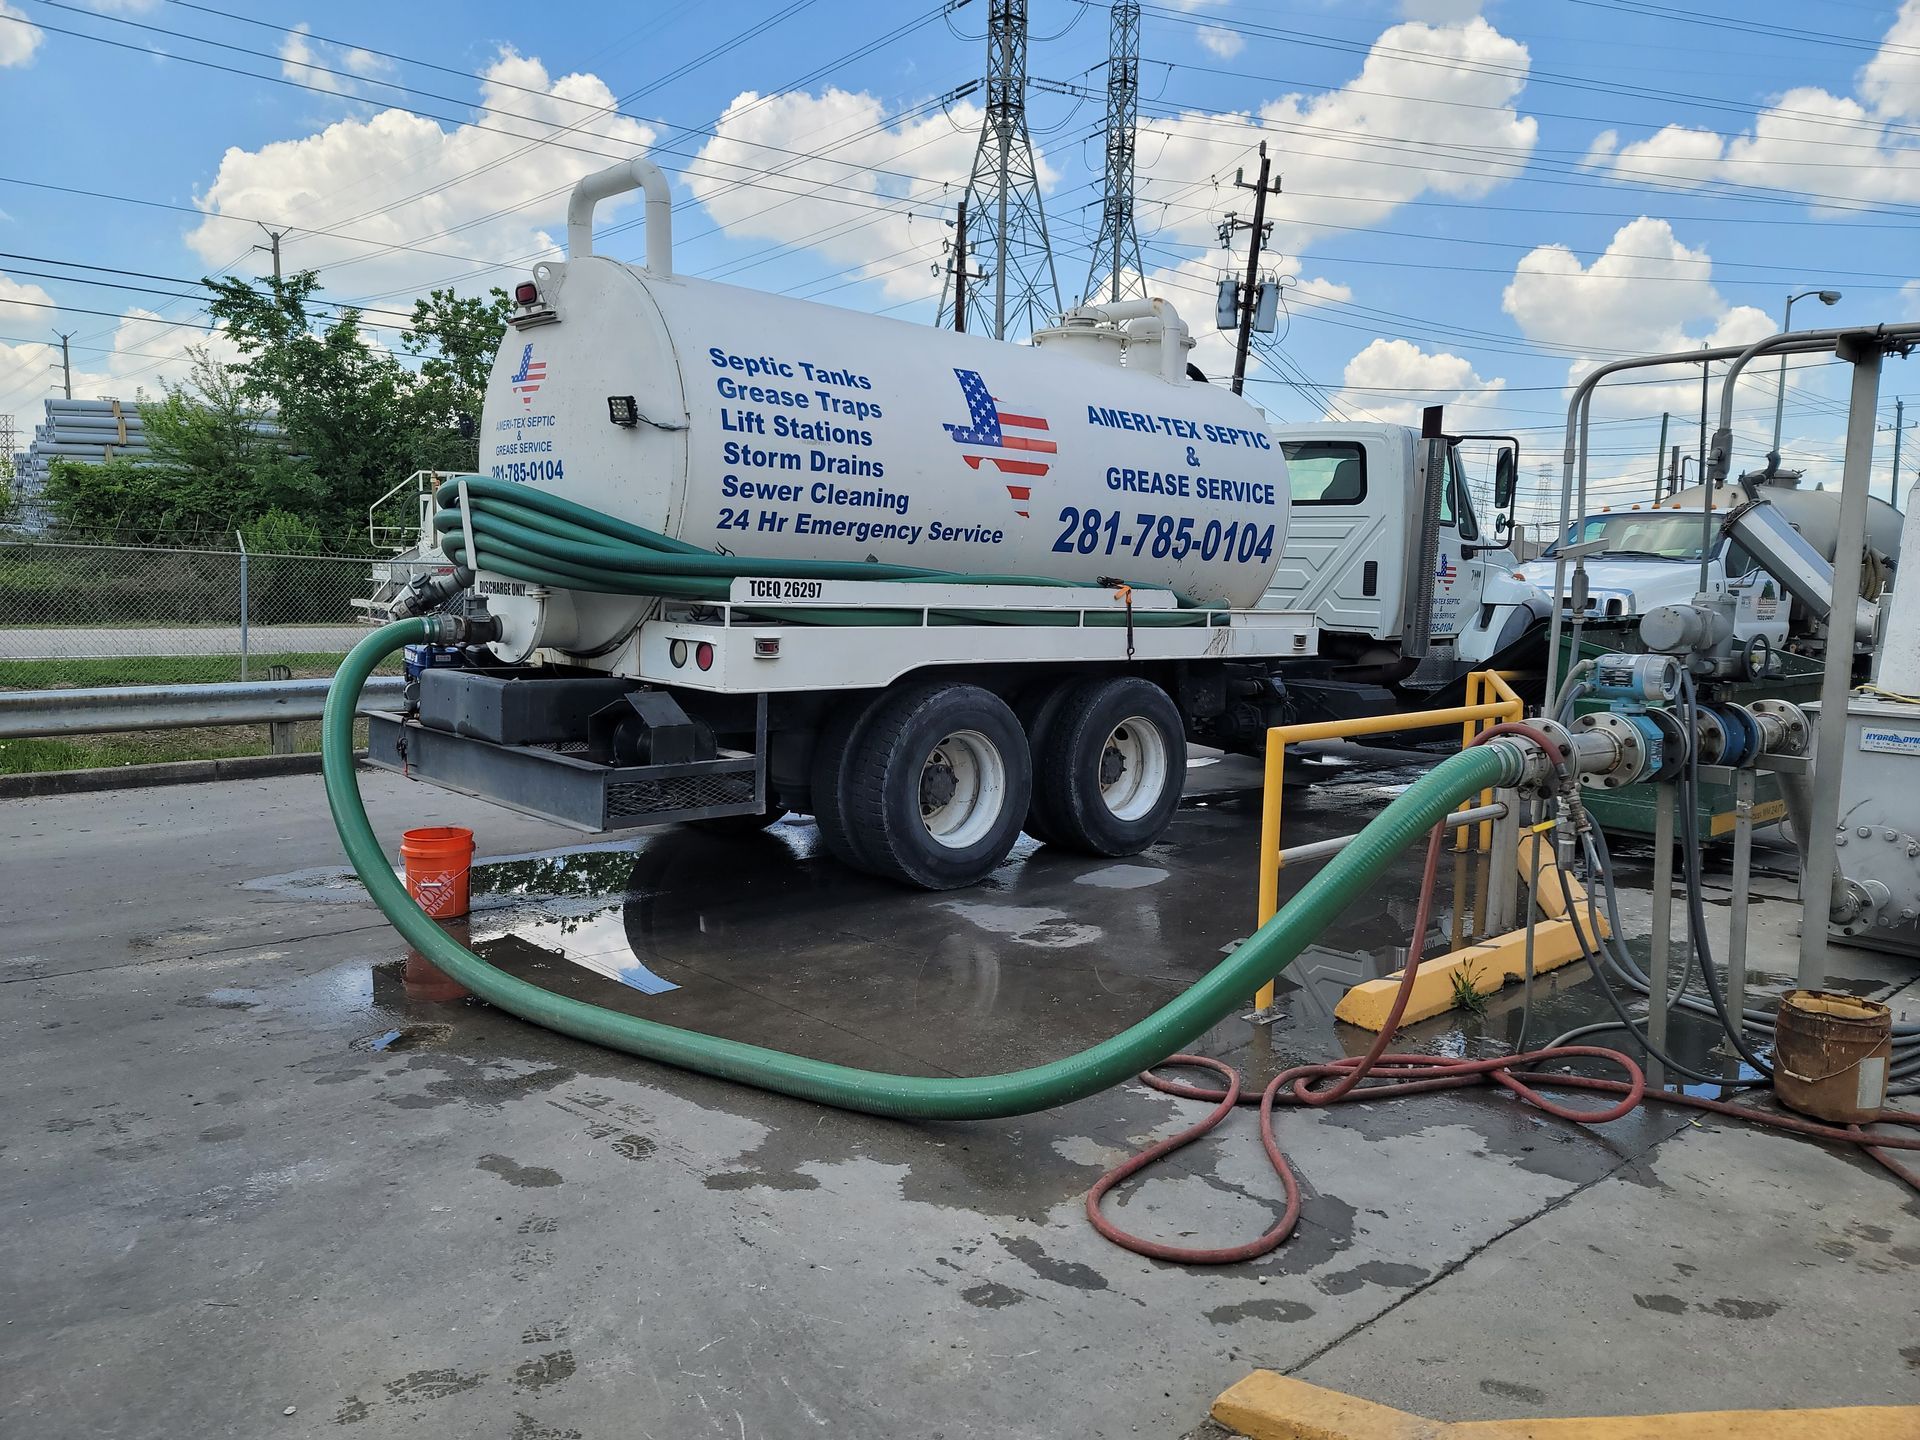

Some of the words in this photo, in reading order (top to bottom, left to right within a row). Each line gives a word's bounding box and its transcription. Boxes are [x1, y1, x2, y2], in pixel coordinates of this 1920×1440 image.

[709, 347, 794, 379] Septic
[798, 361, 872, 390] Tanks
[717, 377, 809, 409] Grease
[815, 390, 883, 421] Traps
[496, 417, 526, 432] AMERI-TEX
[527, 415, 556, 428] SEPTIC
[517, 430, 522, 441] &
[721, 408, 765, 435] Lift
[773, 414, 873, 447] Stations
[1087, 405, 1202, 440] AMERI-TEX
[1204, 423, 1271, 450] SEPTIC
[496, 443, 518, 456] GREASE
[519, 441, 552, 454] SERVICE
[723, 441, 800, 471] Storm
[810, 450, 884, 478] Drains
[1186, 446, 1201, 467] &
[491, 459, 564, 482] 281-785-0104
[1106, 466, 1190, 497] GREASE
[1196, 476, 1275, 505] SERVICE
[722, 474, 803, 502] Sewer
[810, 482, 910, 515] Cleaning
[716, 508, 750, 531] 24
[757, 510, 789, 534] Hr
[794, 512, 923, 545] Emergency
[928, 521, 1004, 544] Service
[1051, 506, 1275, 564] 281-785-0104
[479, 580, 510, 596] DISCHARGE
[511, 580, 526, 597] ONLY
[749, 580, 781, 598] TCEQ
[784, 581, 823, 599] 26297
